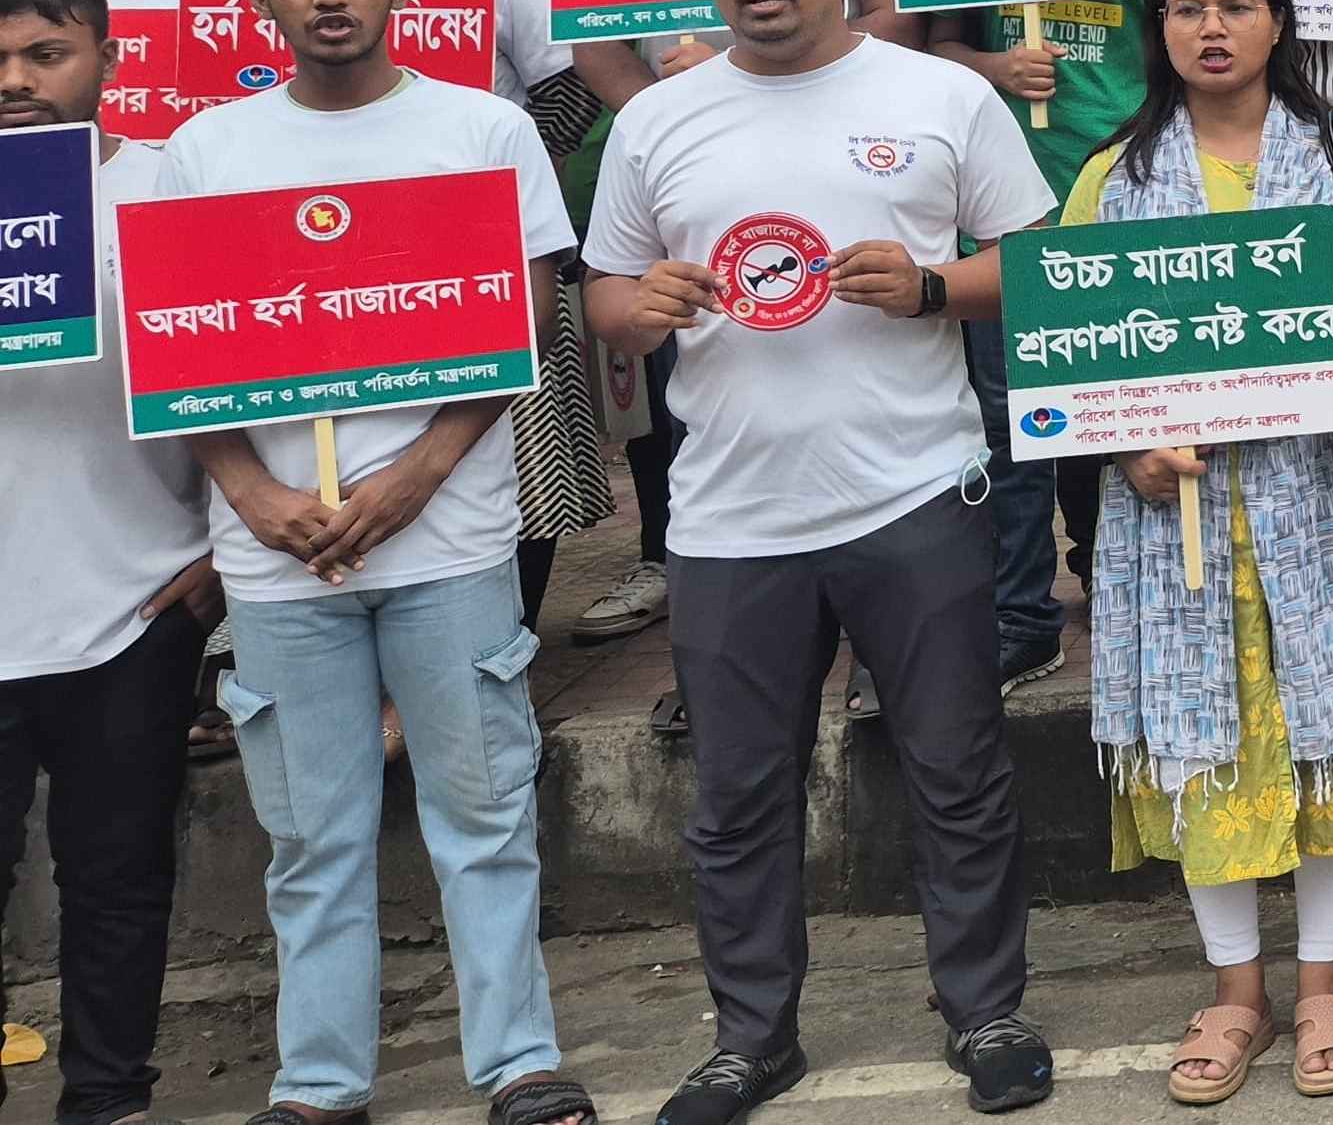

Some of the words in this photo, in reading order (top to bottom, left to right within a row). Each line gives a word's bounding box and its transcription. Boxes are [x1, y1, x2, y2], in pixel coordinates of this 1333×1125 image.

[634, 10, 651, 23] বন
[656, 9, 666, 21] ও
[1064, 2, 1118, 22] LEVEL:
[1003, 18, 1021, 36] ACT
[1057, 22, 1075, 40] TO
[1079, 25, 1107, 44] END
[1053, 41, 1104, 63] OSURE
[1040, 246, 1118, 290] উচ্চ
[1126, 241, 1238, 285] মাত্রার
[1246, 223, 1306, 277] হর্ন
[137, 298, 240, 338] অযথা
[248, 282, 307, 328] হর্ন
[315, 277, 464, 322] বাজাবেন
[473, 269, 514, 302] না
[1014, 307, 1180, 368] শ্রবণশক্তি
[1189, 301, 1248, 351] নষ্ট
[168, 391, 243, 417] পরিবেশ,
[248, 388, 273, 408] বন
[279, 387, 293, 404] ও
[299, 379, 359, 401] জলবায়ু
[362, 369, 431, 394] পরিবর্তন
[434, 362, 499, 386] মন্ত্রণালয়
[1208, 379, 1217, 392] ও
[1073, 408, 1115, 424] পরিবেশ
[1121, 403, 1168, 419] অধিদপ্তর
[1129, 428, 1144, 441] বন
[1149, 427, 1158, 439] ও
[1206, 415, 1252, 432] পরিবর্তন
